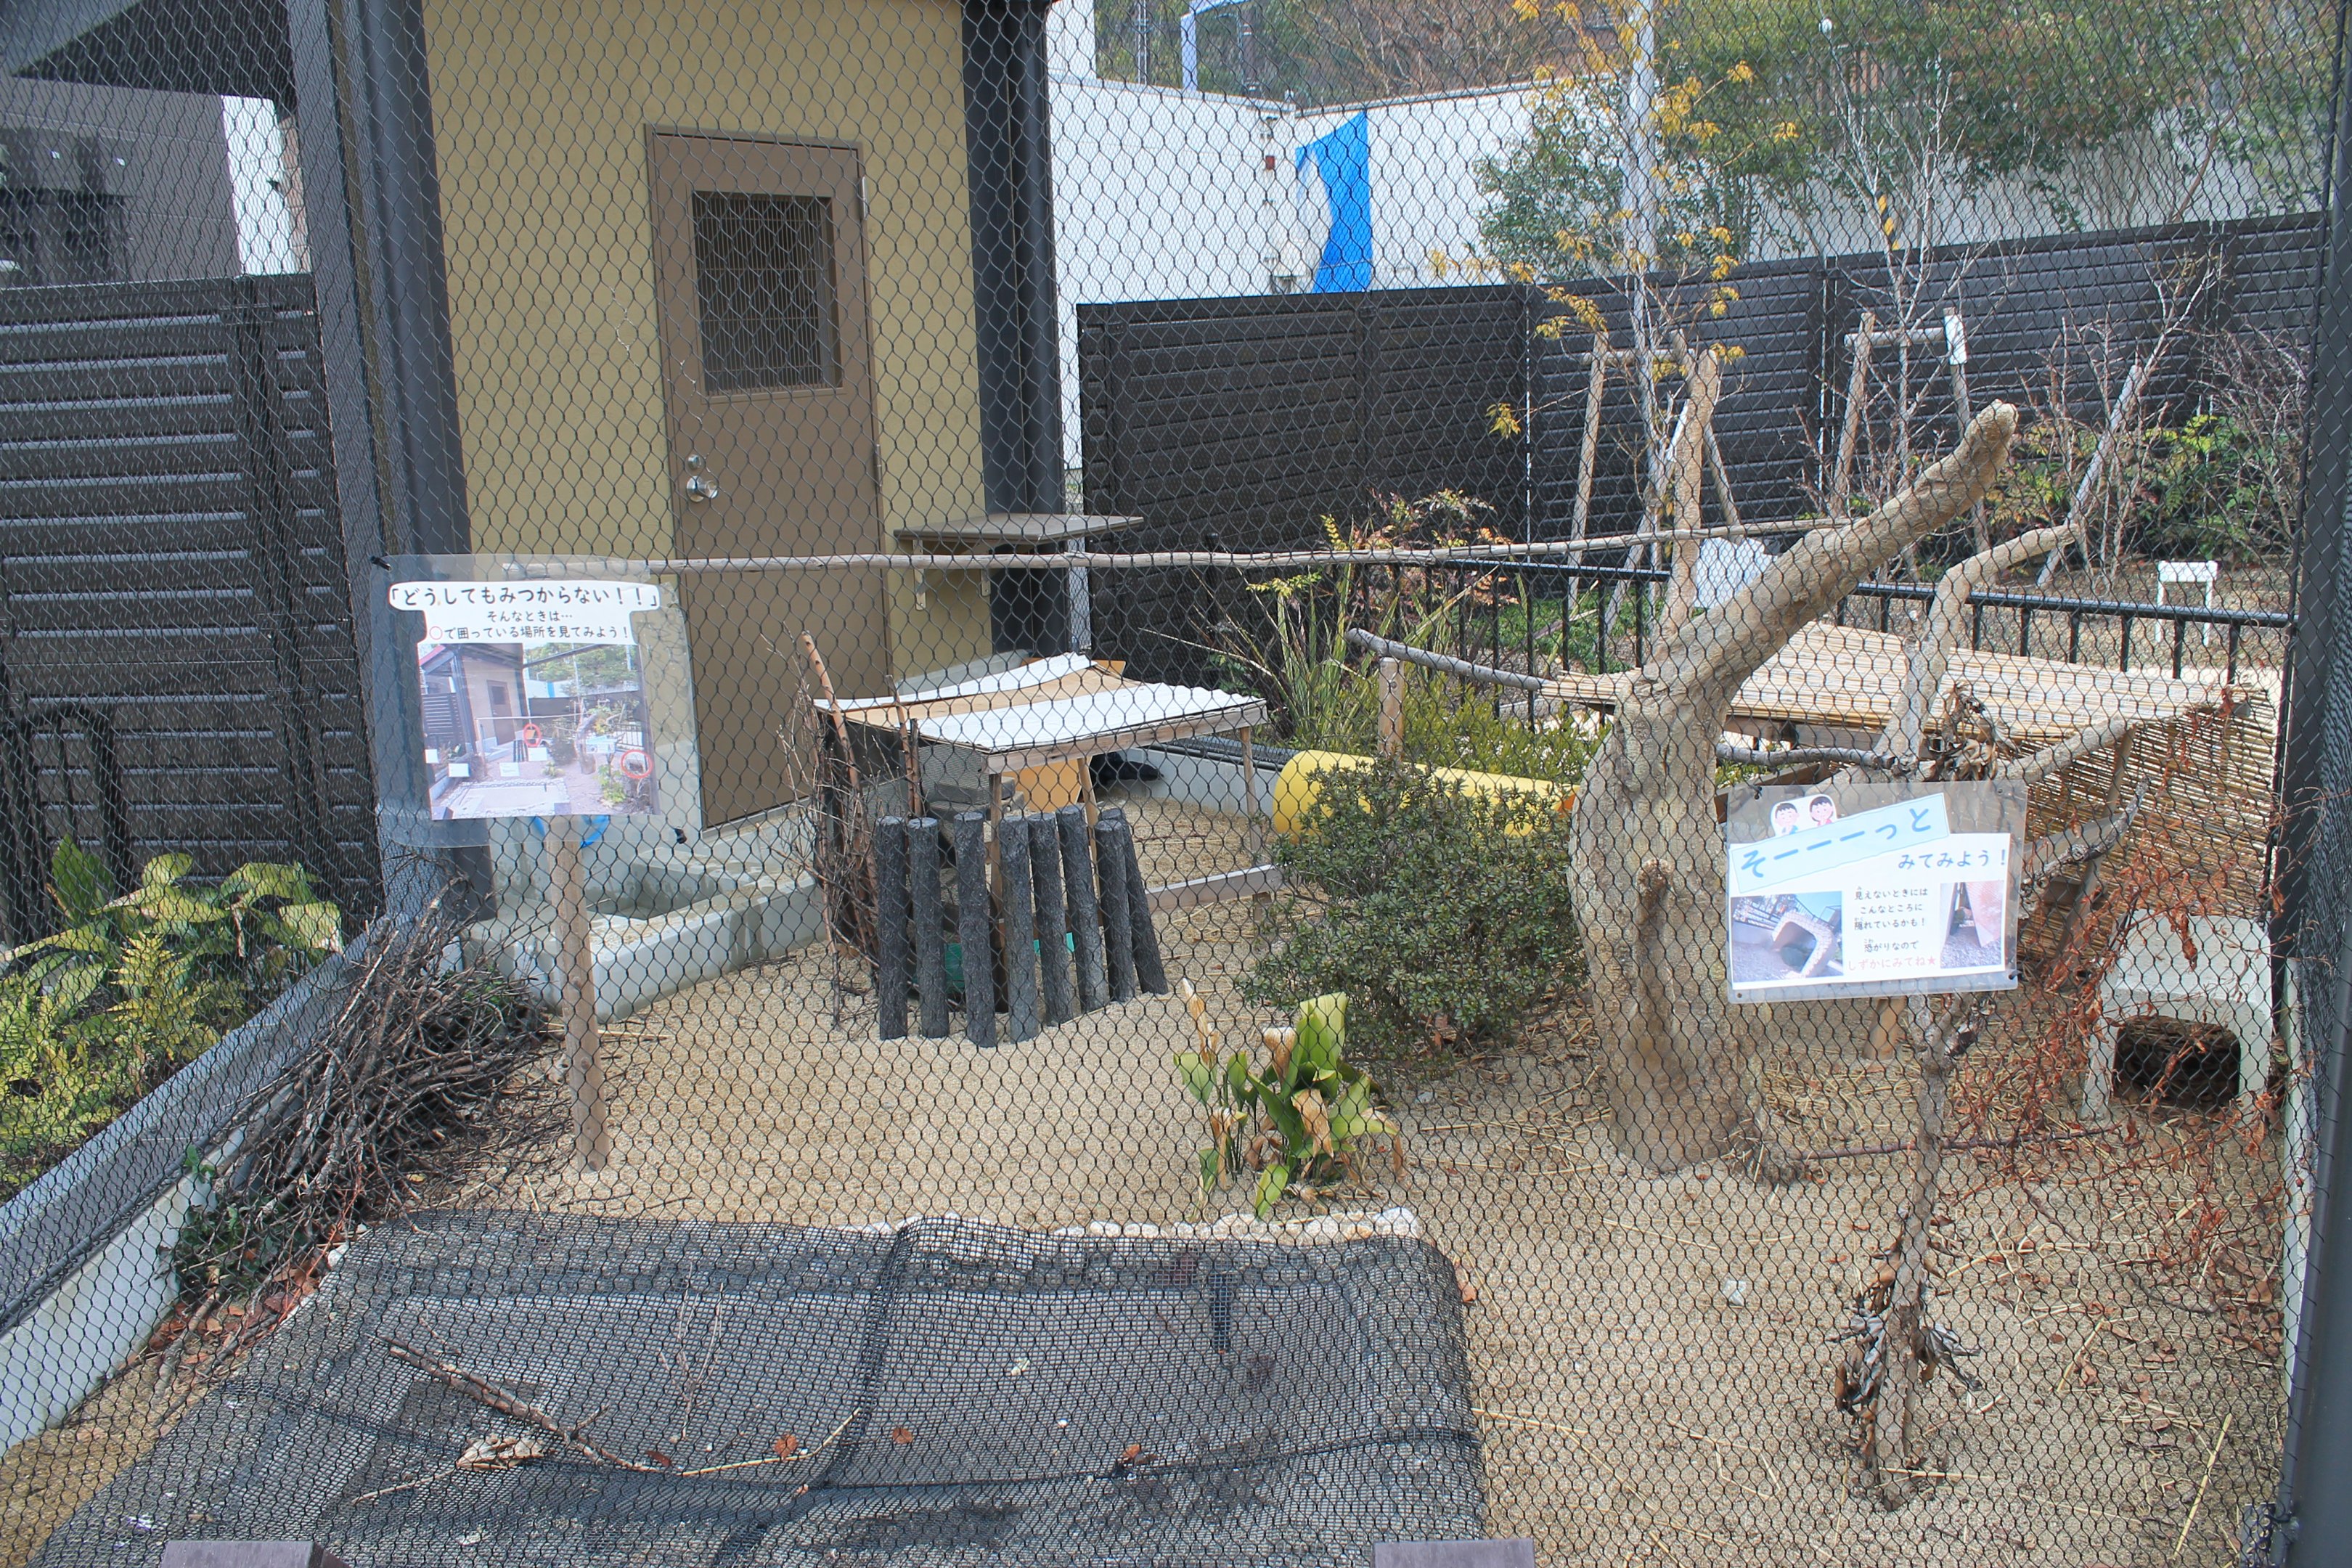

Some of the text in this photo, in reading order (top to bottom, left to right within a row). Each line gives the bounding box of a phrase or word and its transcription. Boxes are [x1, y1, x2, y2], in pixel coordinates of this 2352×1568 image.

[1898, 849, 2006, 870] みてみよう！
[1854, 888, 1928, 901] 見えないときには
[1860, 904, 1923, 915] こんなところに
[1863, 940, 1919, 953] 恐がりなので
